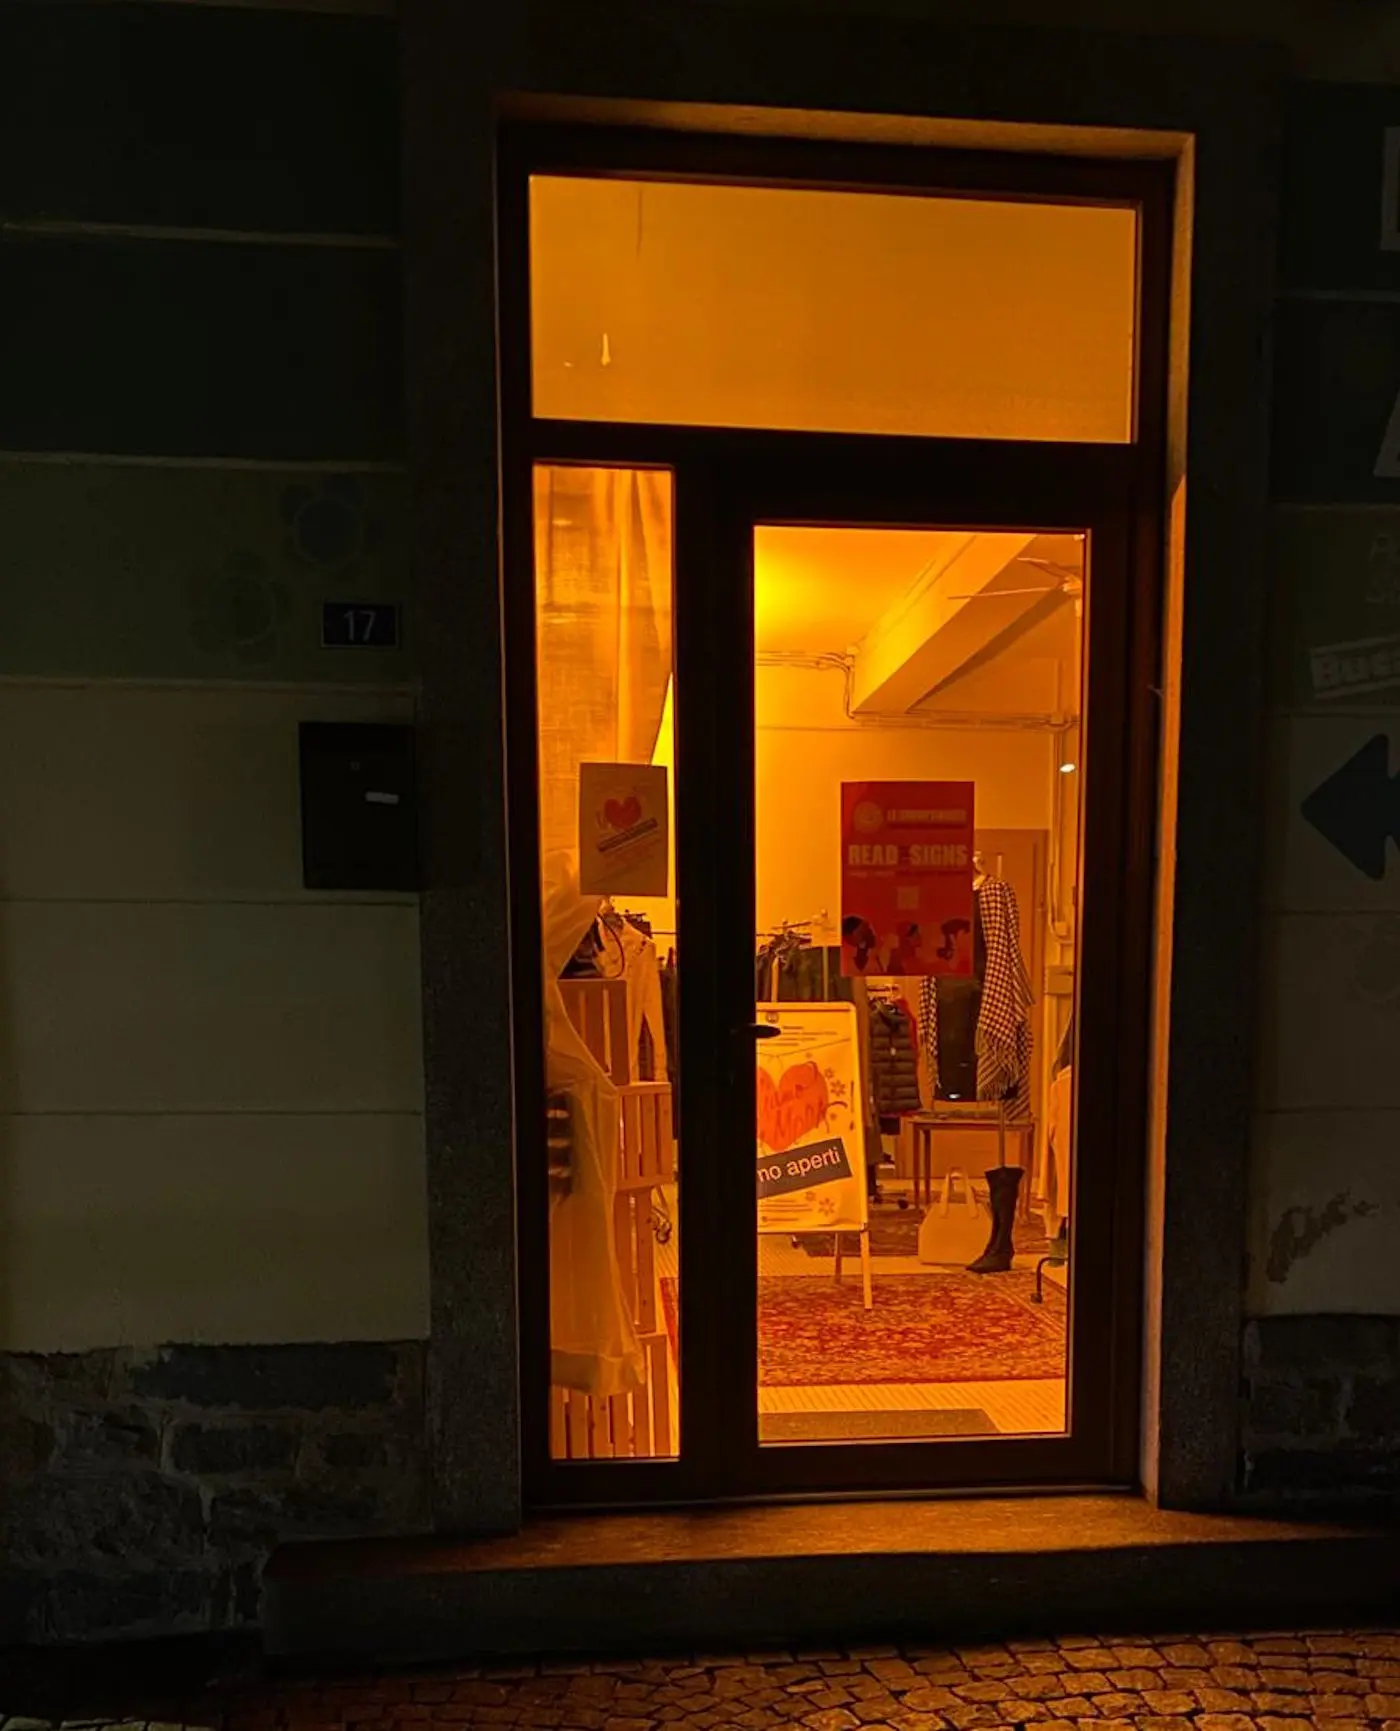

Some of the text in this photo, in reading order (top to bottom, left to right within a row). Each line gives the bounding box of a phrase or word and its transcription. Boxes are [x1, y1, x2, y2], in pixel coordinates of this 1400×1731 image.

[344, 610, 376, 641] 17
[848, 844, 968, 866] READ SIGNS
[786, 1146, 841, 1177] aperti
